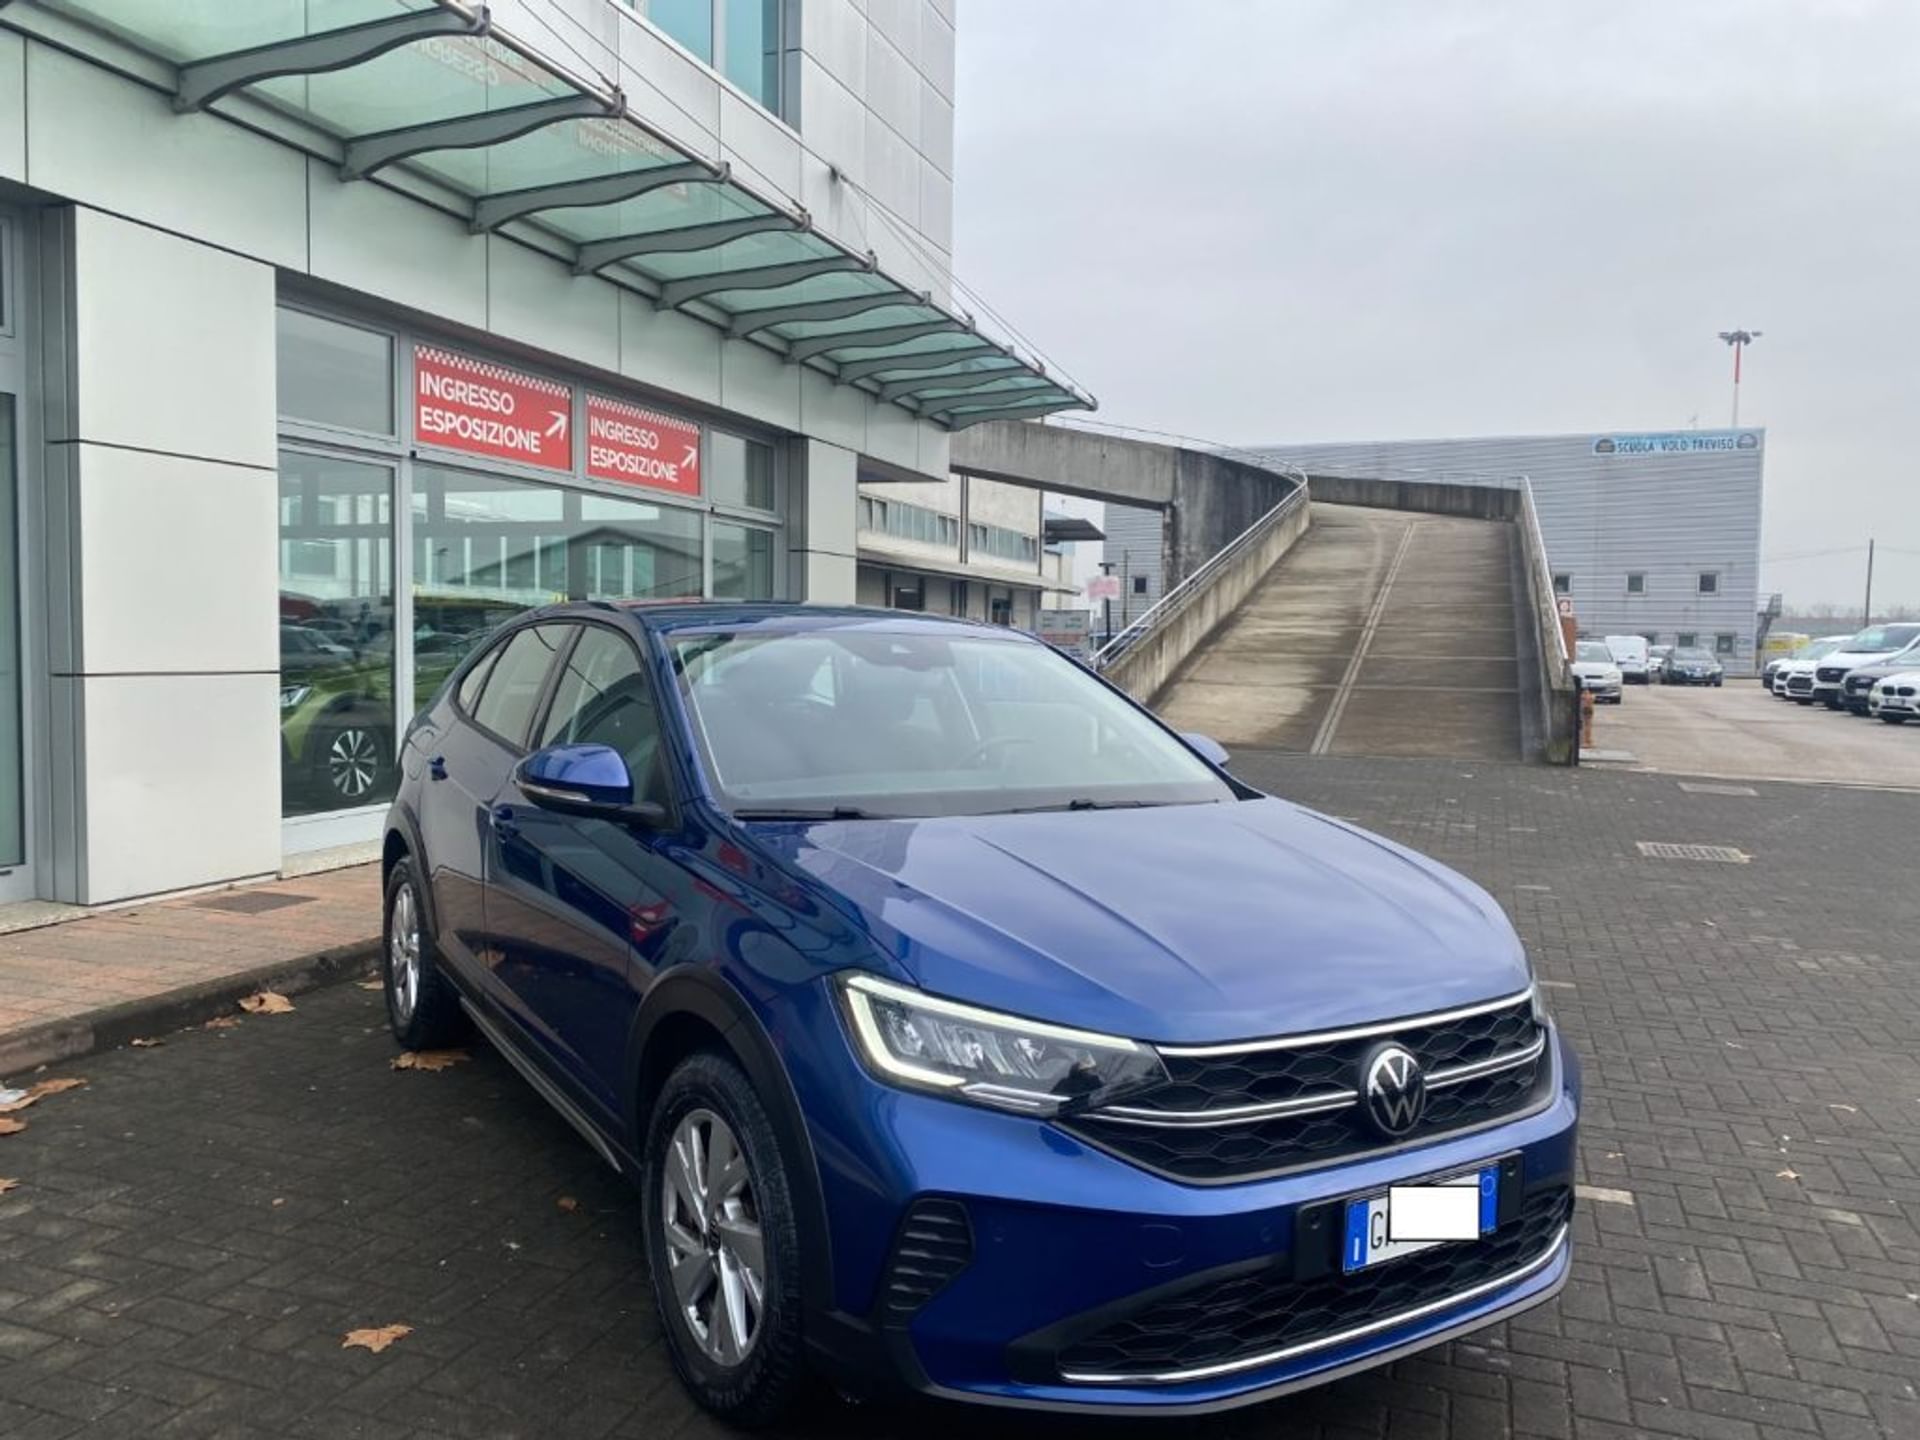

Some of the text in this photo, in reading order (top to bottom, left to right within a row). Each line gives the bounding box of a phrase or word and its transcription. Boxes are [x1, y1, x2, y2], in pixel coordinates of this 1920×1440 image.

[420, 371, 515, 416] INGRESSO
[420, 406, 542, 454] ESPOSIZIONE
[590, 415, 660, 451] INGRESSO
[1617, 437, 1734, 454] SCUOLA VOLO TREVISO
[590, 445, 679, 483] ESPOSIZIONE
